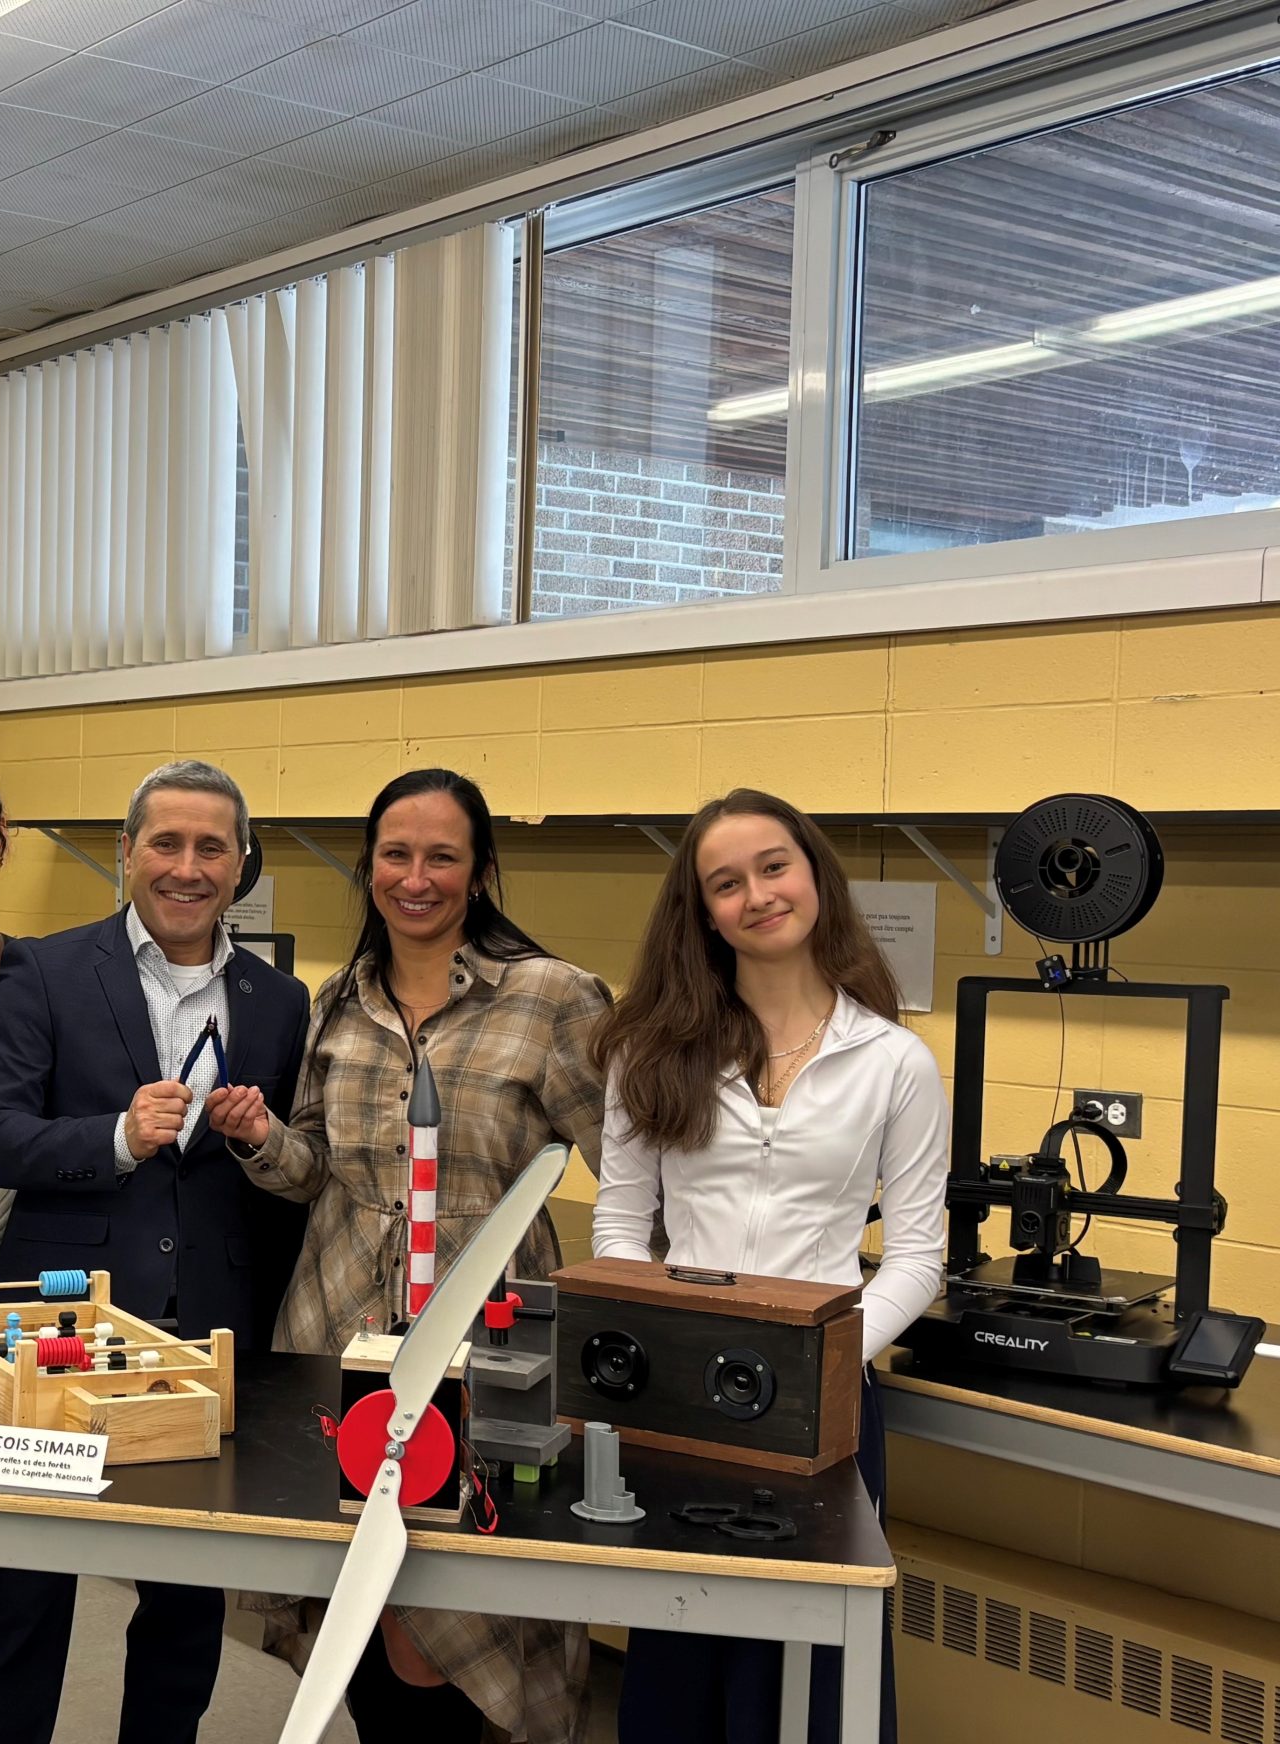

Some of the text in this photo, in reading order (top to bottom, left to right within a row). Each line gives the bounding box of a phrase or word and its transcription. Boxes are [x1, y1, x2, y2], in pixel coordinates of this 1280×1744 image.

[974, 1331, 1049, 1351] CREALITY
[33, 1439, 98, 1459] SIMARD
[2, 1466, 11, 1475] de
[12, 1467, 19, 1476] la
[23, 1458, 31, 1466] et
[33, 1458, 46, 1468] des
[48, 1460, 71, 1470] forêts
